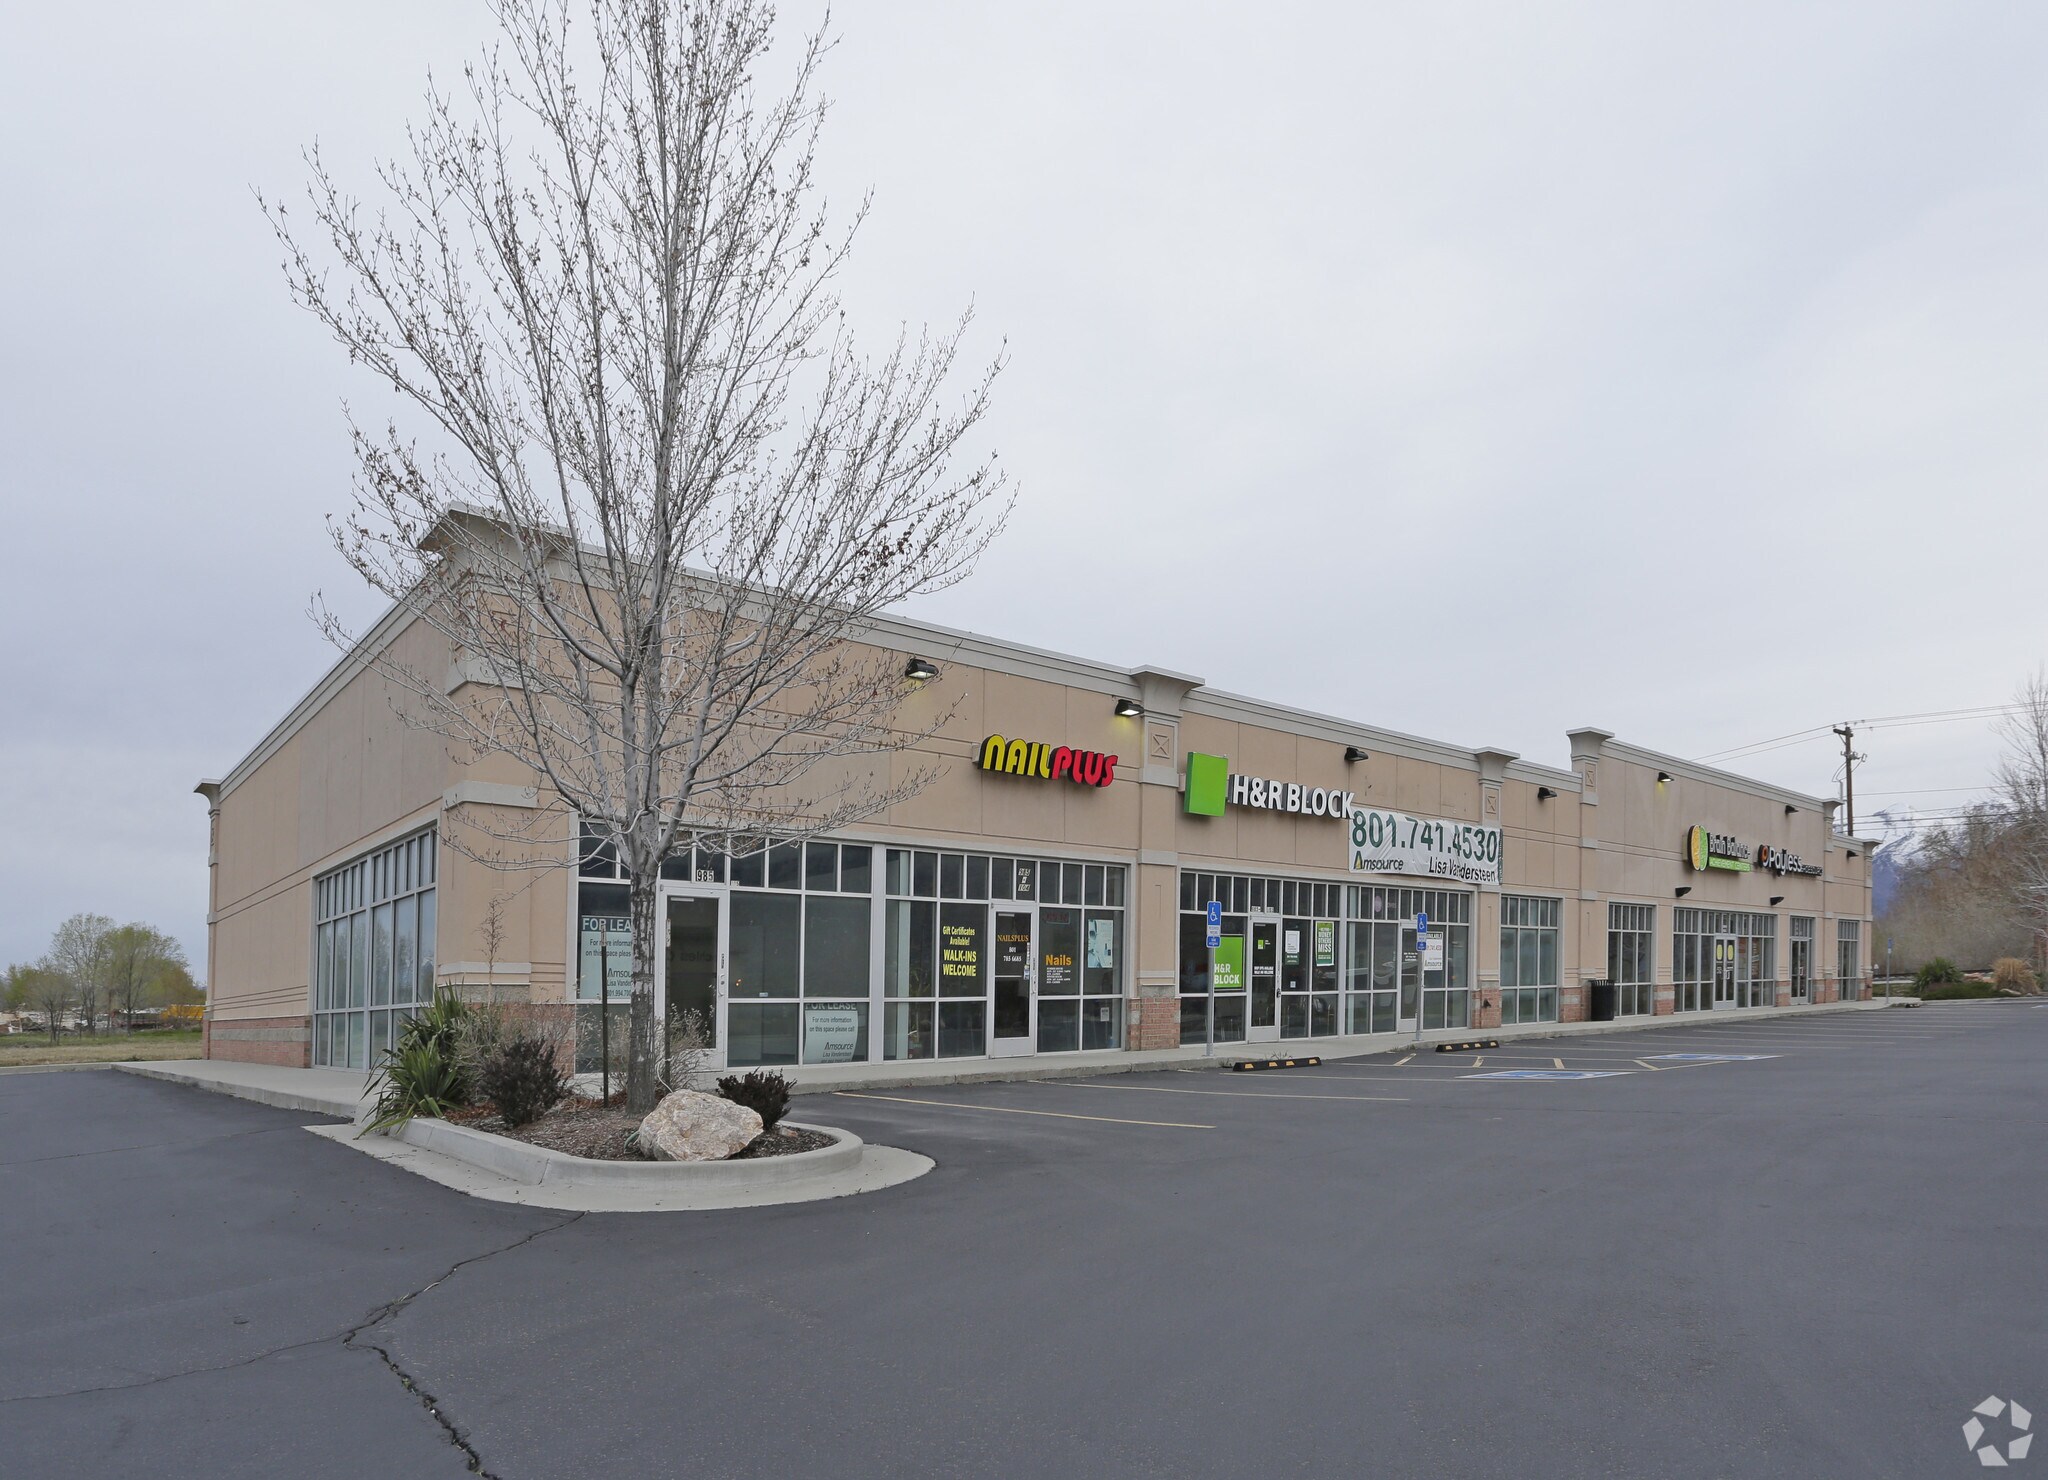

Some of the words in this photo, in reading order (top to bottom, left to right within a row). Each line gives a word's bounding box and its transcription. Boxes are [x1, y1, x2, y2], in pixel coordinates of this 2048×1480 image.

[1285, 782, 1355, 819] BLOCK
[1352, 811, 1498, 863] 801.741.4530
[1353, 850, 1404, 870] Amsource
[1428, 856, 1448, 874] Lisa
[1449, 858, 1496, 882] Vandersteen
[1769, 846, 1802, 876] Payless
[696, 869, 714, 881] 985
[582, 917, 606, 931] FOR
[610, 919, 631, 932] LEA
[943, 926, 951, 935] Gift
[951, 926, 975, 936] Certificates
[1318, 943, 1331, 952] MISS
[943, 949, 977, 962] WALK-INS
[1045, 954, 1072, 966] Nails
[607, 968, 631, 978] Amsou
[943, 963, 977, 976] WELCOME
[1214, 963, 1231, 973] H&R
[1214, 974, 1240, 985] BLOCK
[827, 1002, 856, 1010] LEASE
[824, 1041, 854, 1051] Amsource
